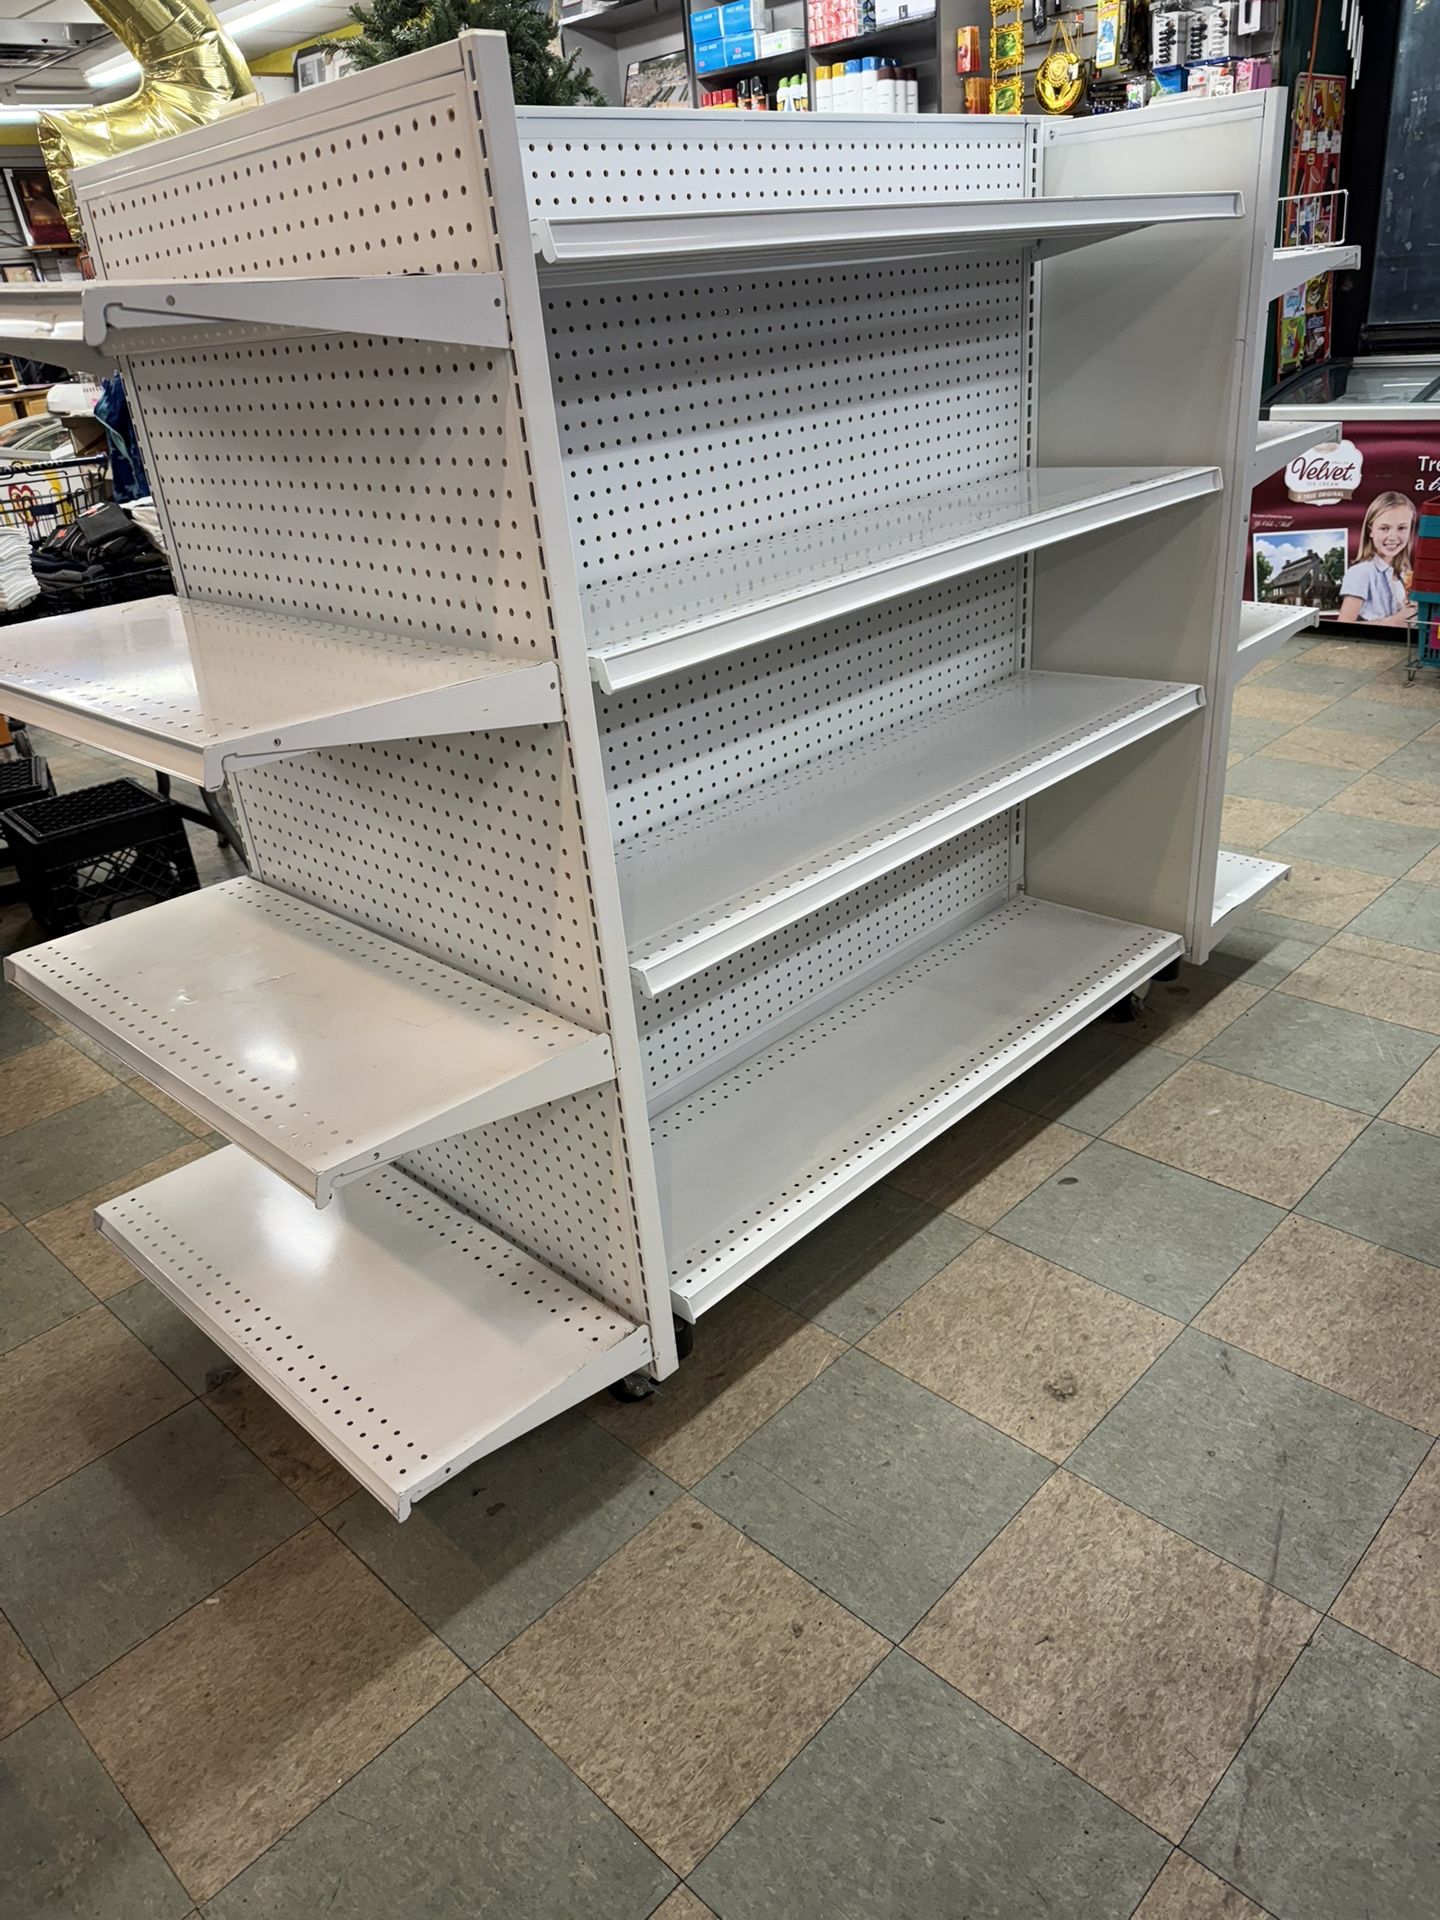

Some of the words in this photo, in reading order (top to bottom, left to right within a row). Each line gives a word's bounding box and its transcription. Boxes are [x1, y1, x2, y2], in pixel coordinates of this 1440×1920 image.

[1291, 457, 1355, 481] Velvet
[1415, 478, 1425, 491] a
[1318, 490, 1344, 498] ORIGINAL
